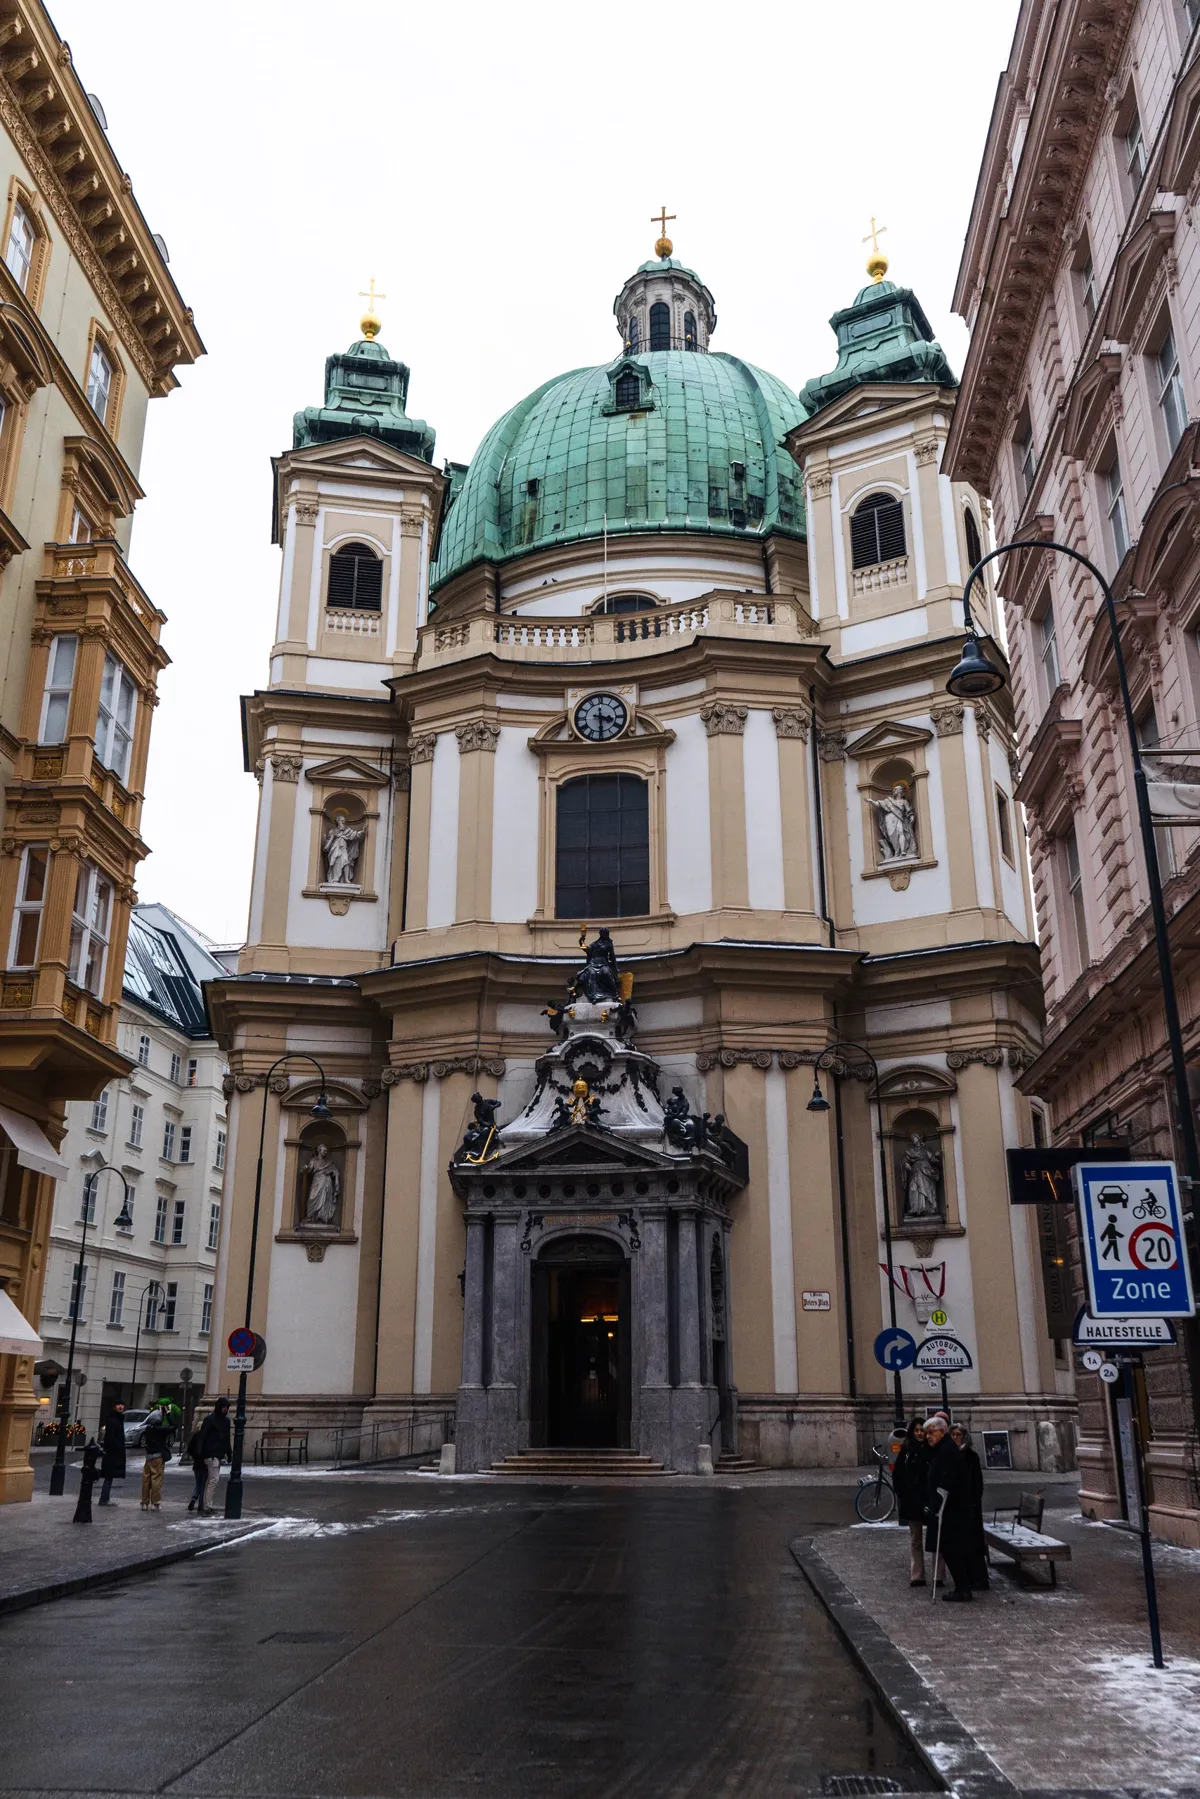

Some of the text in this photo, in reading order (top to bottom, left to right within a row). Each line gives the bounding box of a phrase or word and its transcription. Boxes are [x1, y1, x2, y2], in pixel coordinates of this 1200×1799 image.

[1023, 1169, 1037, 1178] LE
[1142, 1236, 1171, 1263] 20
[1110, 1277, 1172, 1300] Zone
[935, 1312, 944, 1323] H
[1086, 1326, 1162, 1338] HALTESTELLE
[925, 1340, 959, 1352] AUTOBUS
[920, 1357, 965, 1365] HALTESTELLE
[1087, 1356, 1098, 1365] 1A
[1103, 1368, 1115, 1378] 2A
